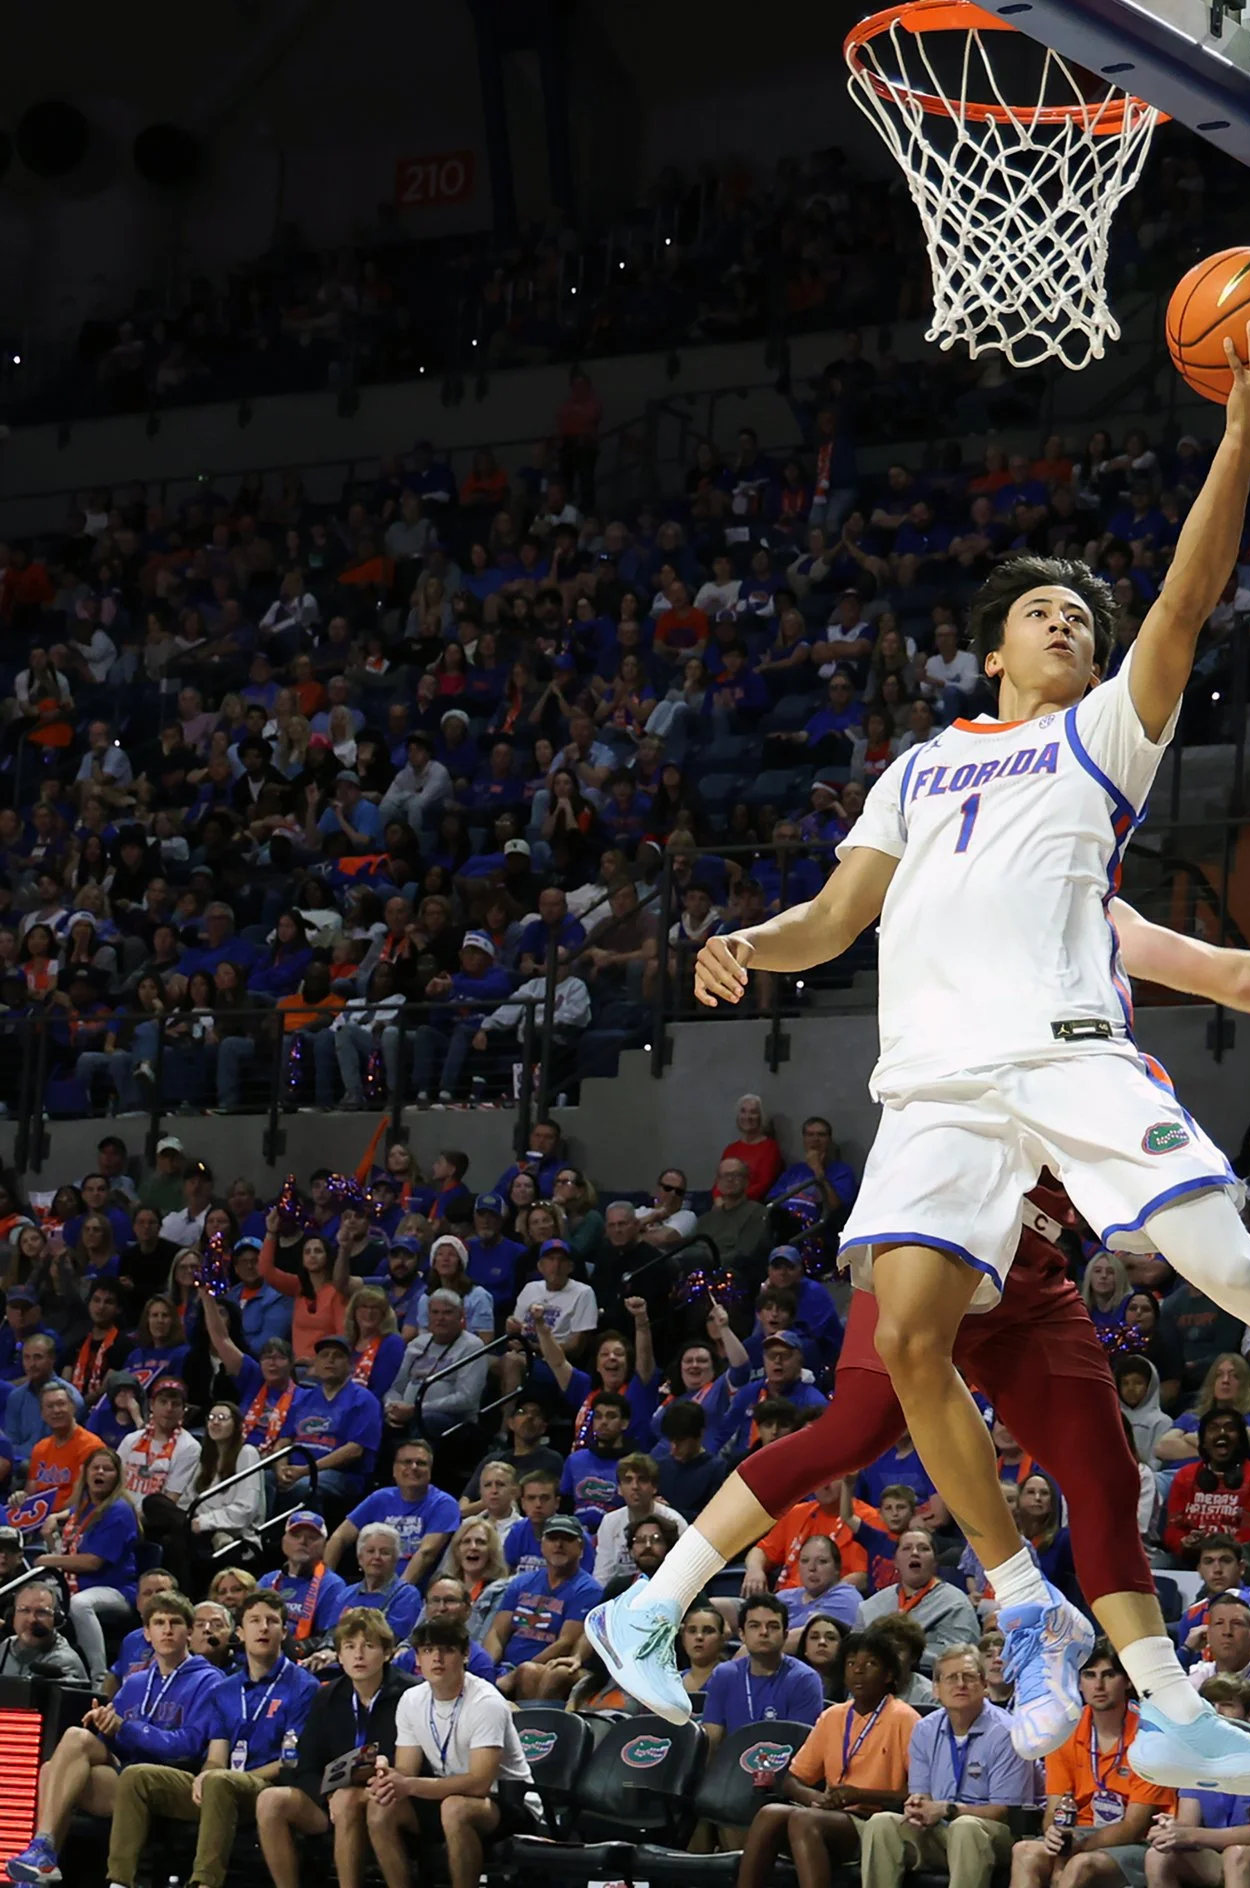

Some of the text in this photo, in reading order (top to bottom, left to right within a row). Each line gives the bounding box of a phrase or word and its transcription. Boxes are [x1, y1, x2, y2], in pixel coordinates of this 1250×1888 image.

[402, 160, 465, 203] 210
[911, 741, 1060, 803] FLORIDA
[954, 793, 981, 854] 1
[1035, 1213, 1048, 1231] C
[1194, 1491, 1239, 1505] MERRY
